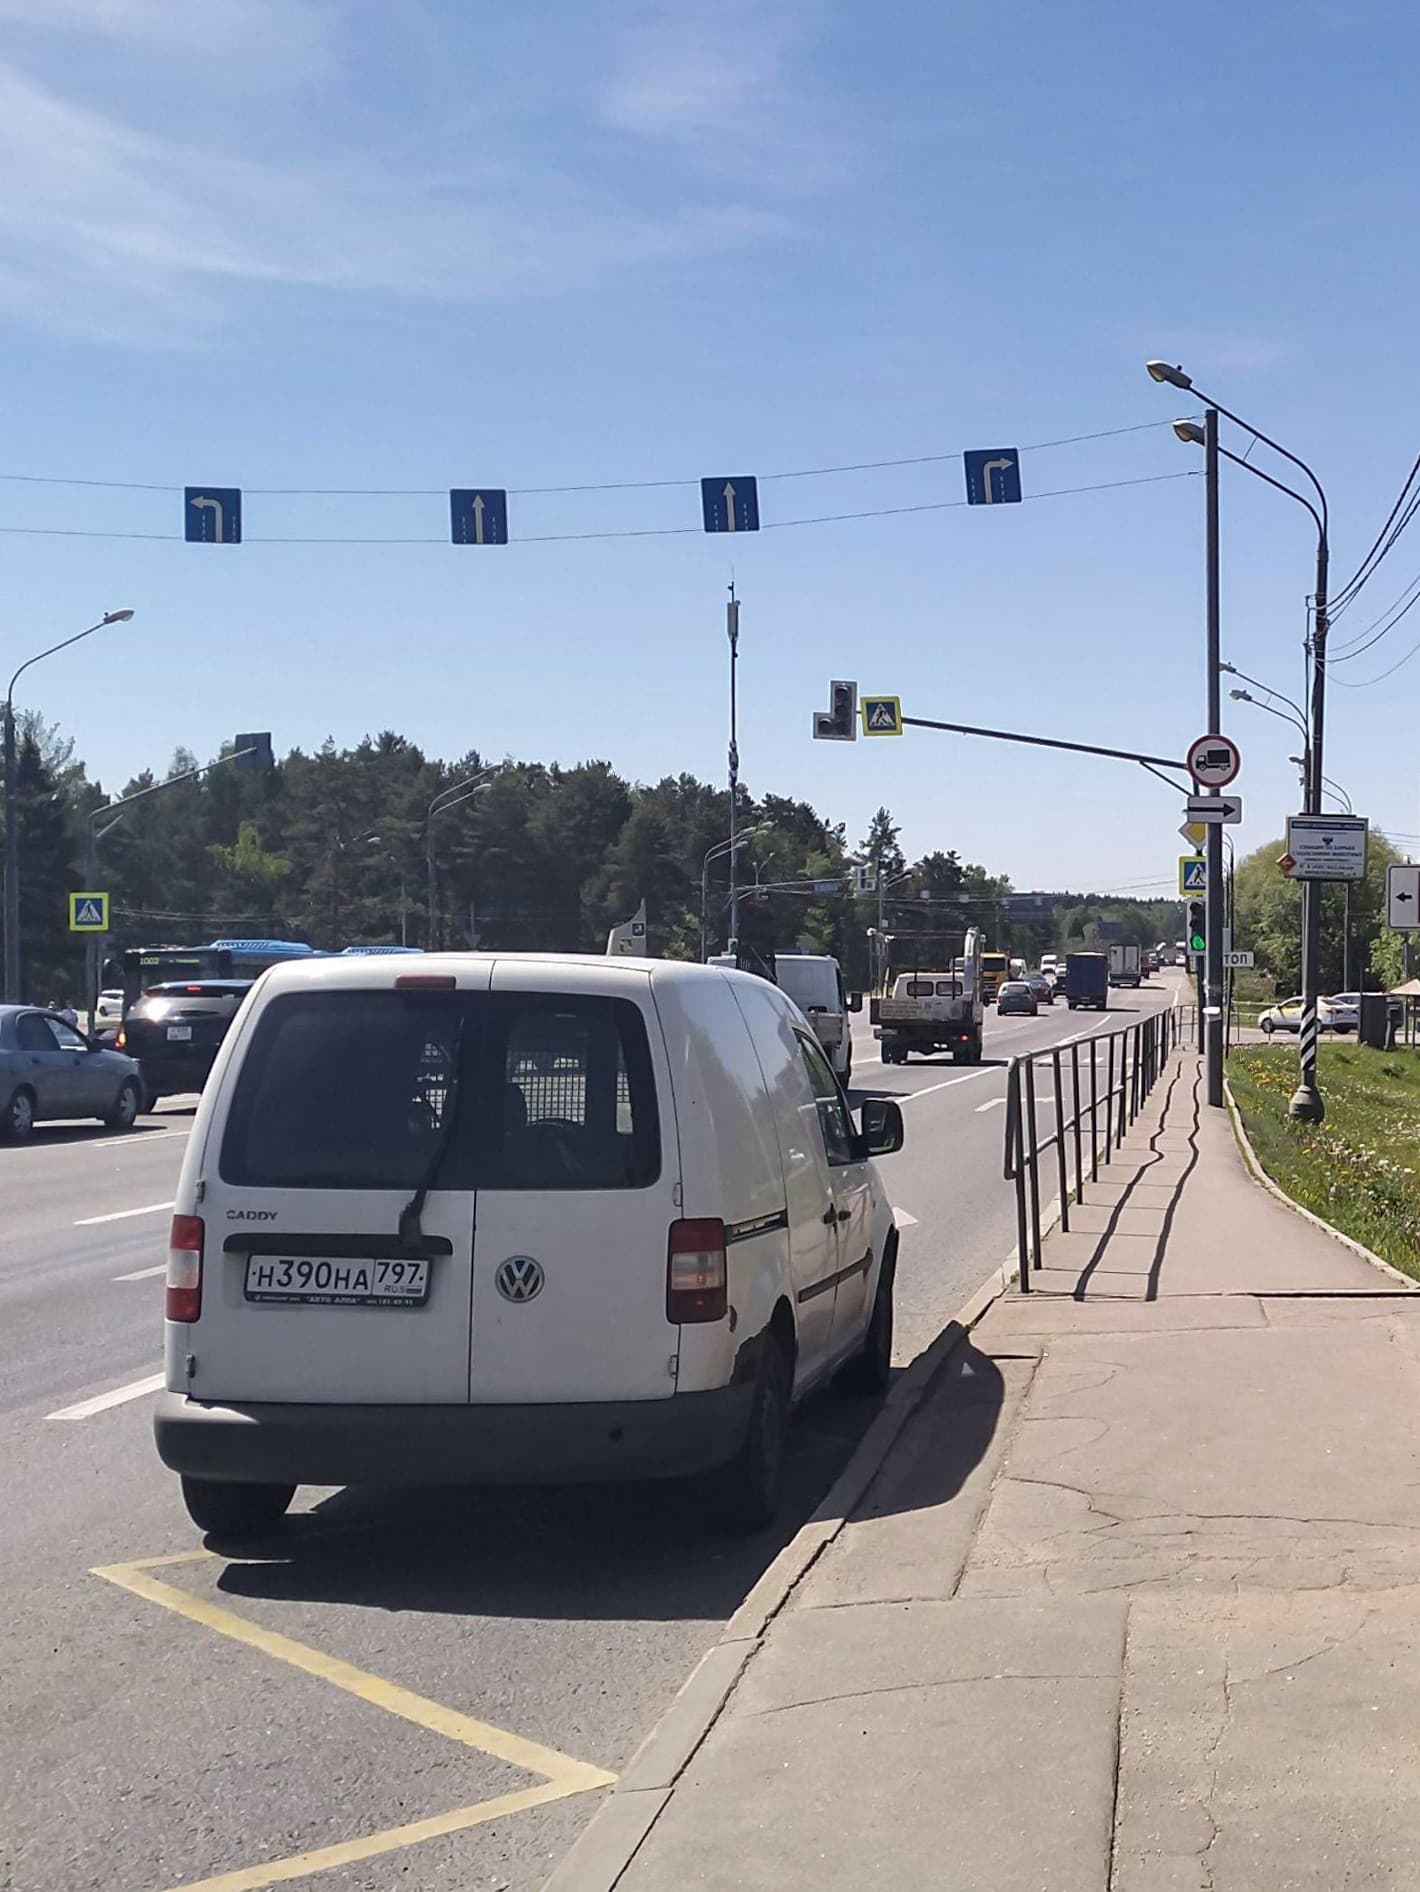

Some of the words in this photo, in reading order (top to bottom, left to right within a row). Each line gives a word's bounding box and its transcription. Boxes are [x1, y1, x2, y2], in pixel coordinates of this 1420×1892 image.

[1224, 954, 1248, 964] ТОП
[226, 1210, 278, 1221] CADDY
[377, 1262, 421, 1284] 797
